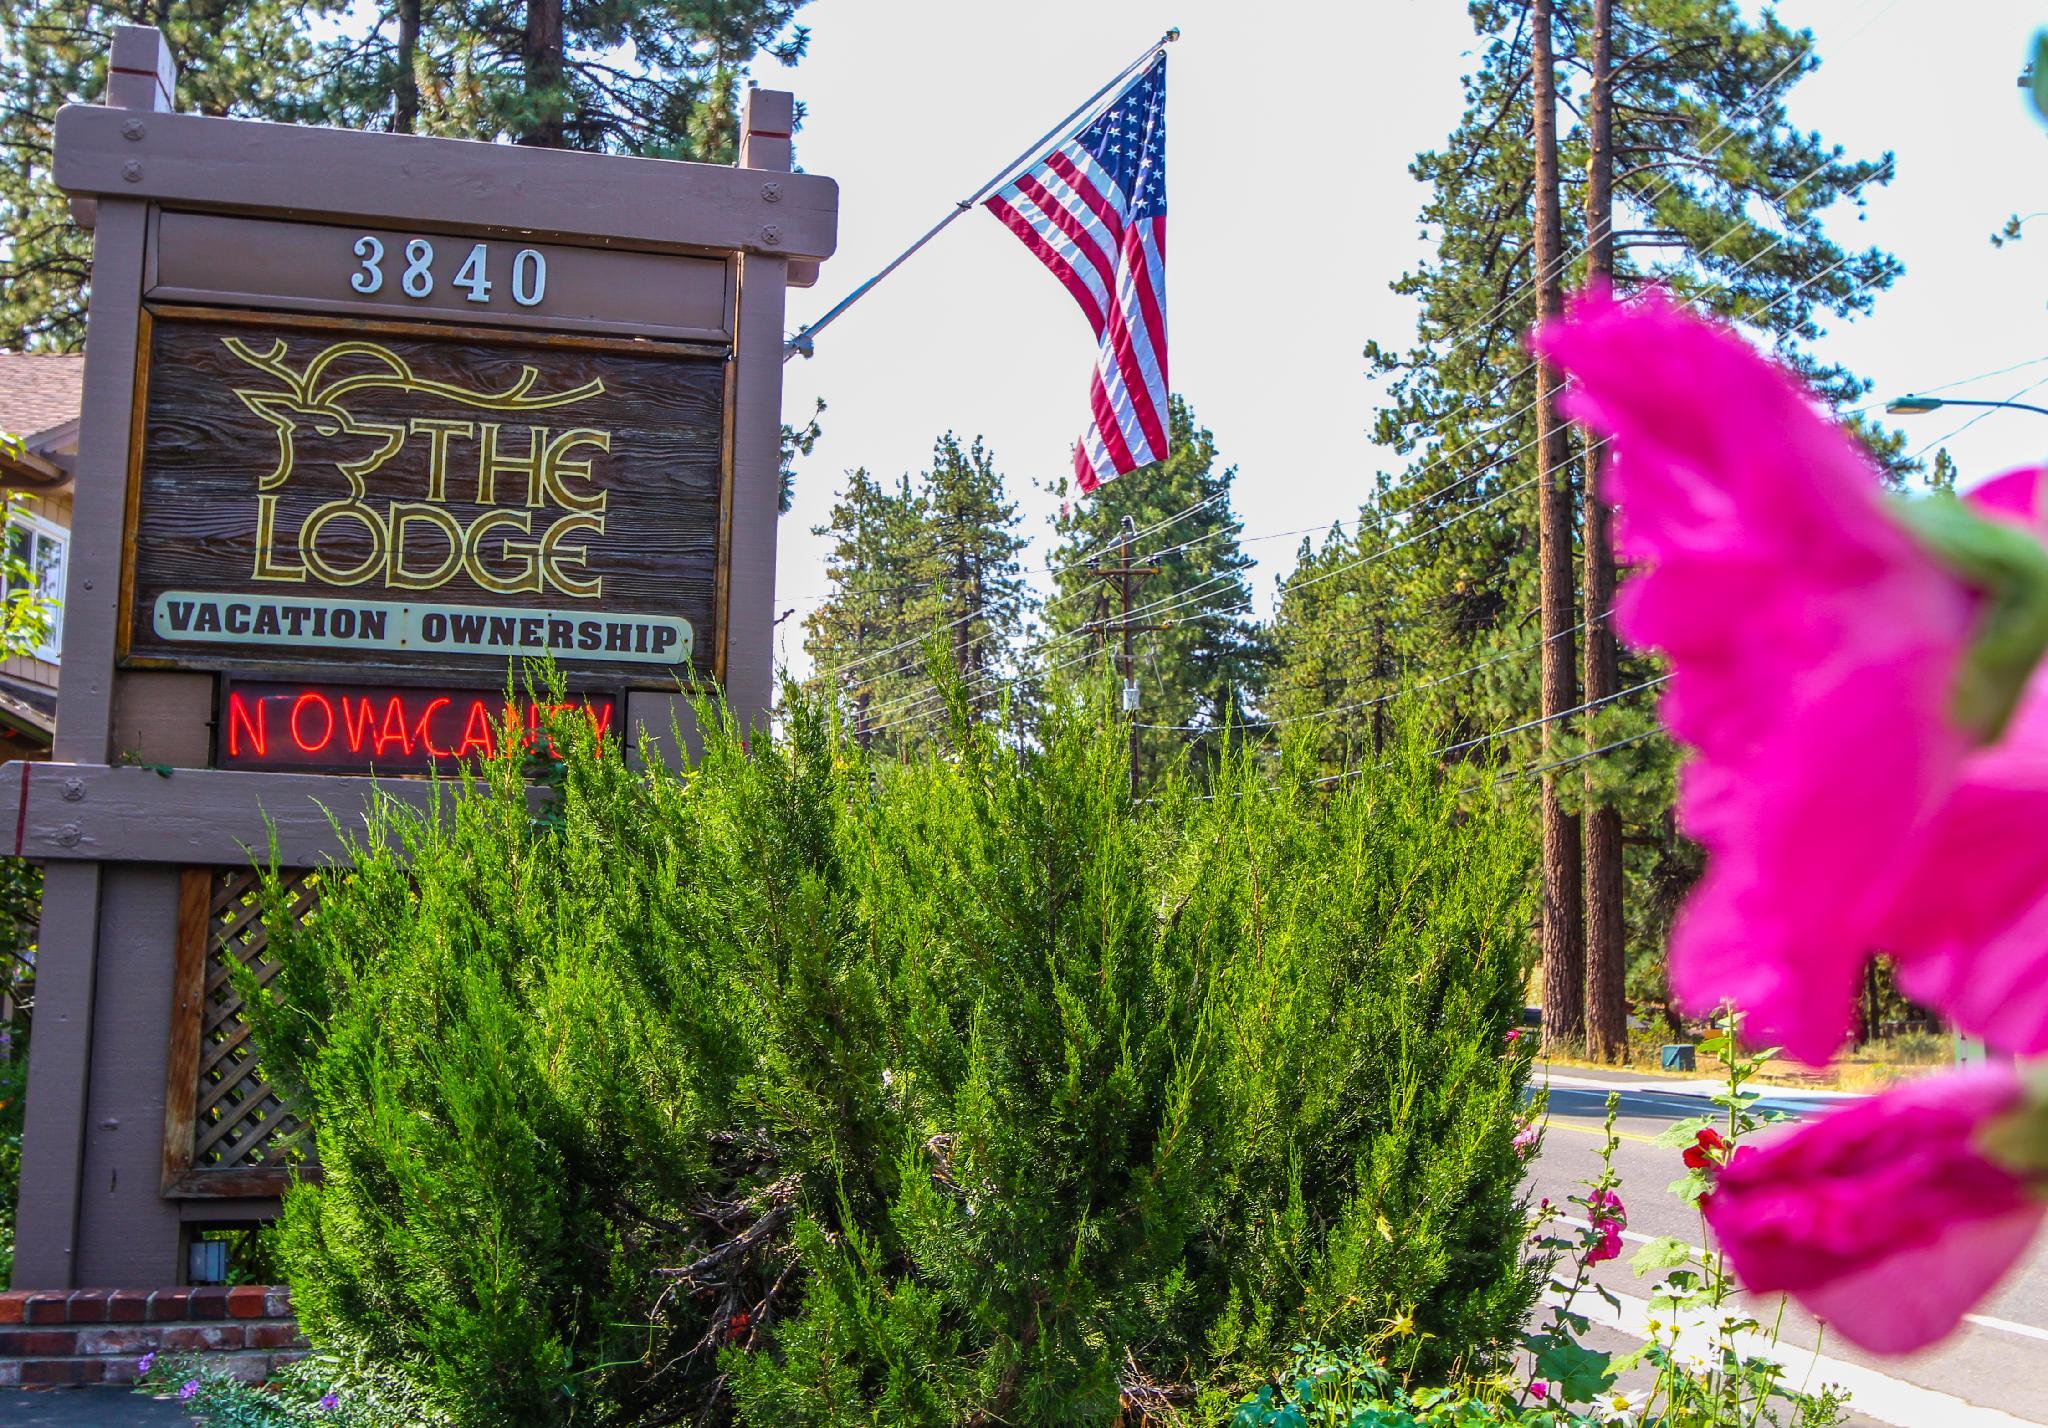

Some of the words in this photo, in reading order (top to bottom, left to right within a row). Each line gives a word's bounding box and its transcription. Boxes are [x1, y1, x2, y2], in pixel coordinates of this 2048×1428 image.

[351, 236, 547, 306] 3840
[410, 418, 611, 513] THE
[252, 494, 606, 599] LODGE
[166, 601, 387, 641] VACATION
[421, 612, 677, 655] OWNERSHIP
[229, 692, 333, 757] NO
